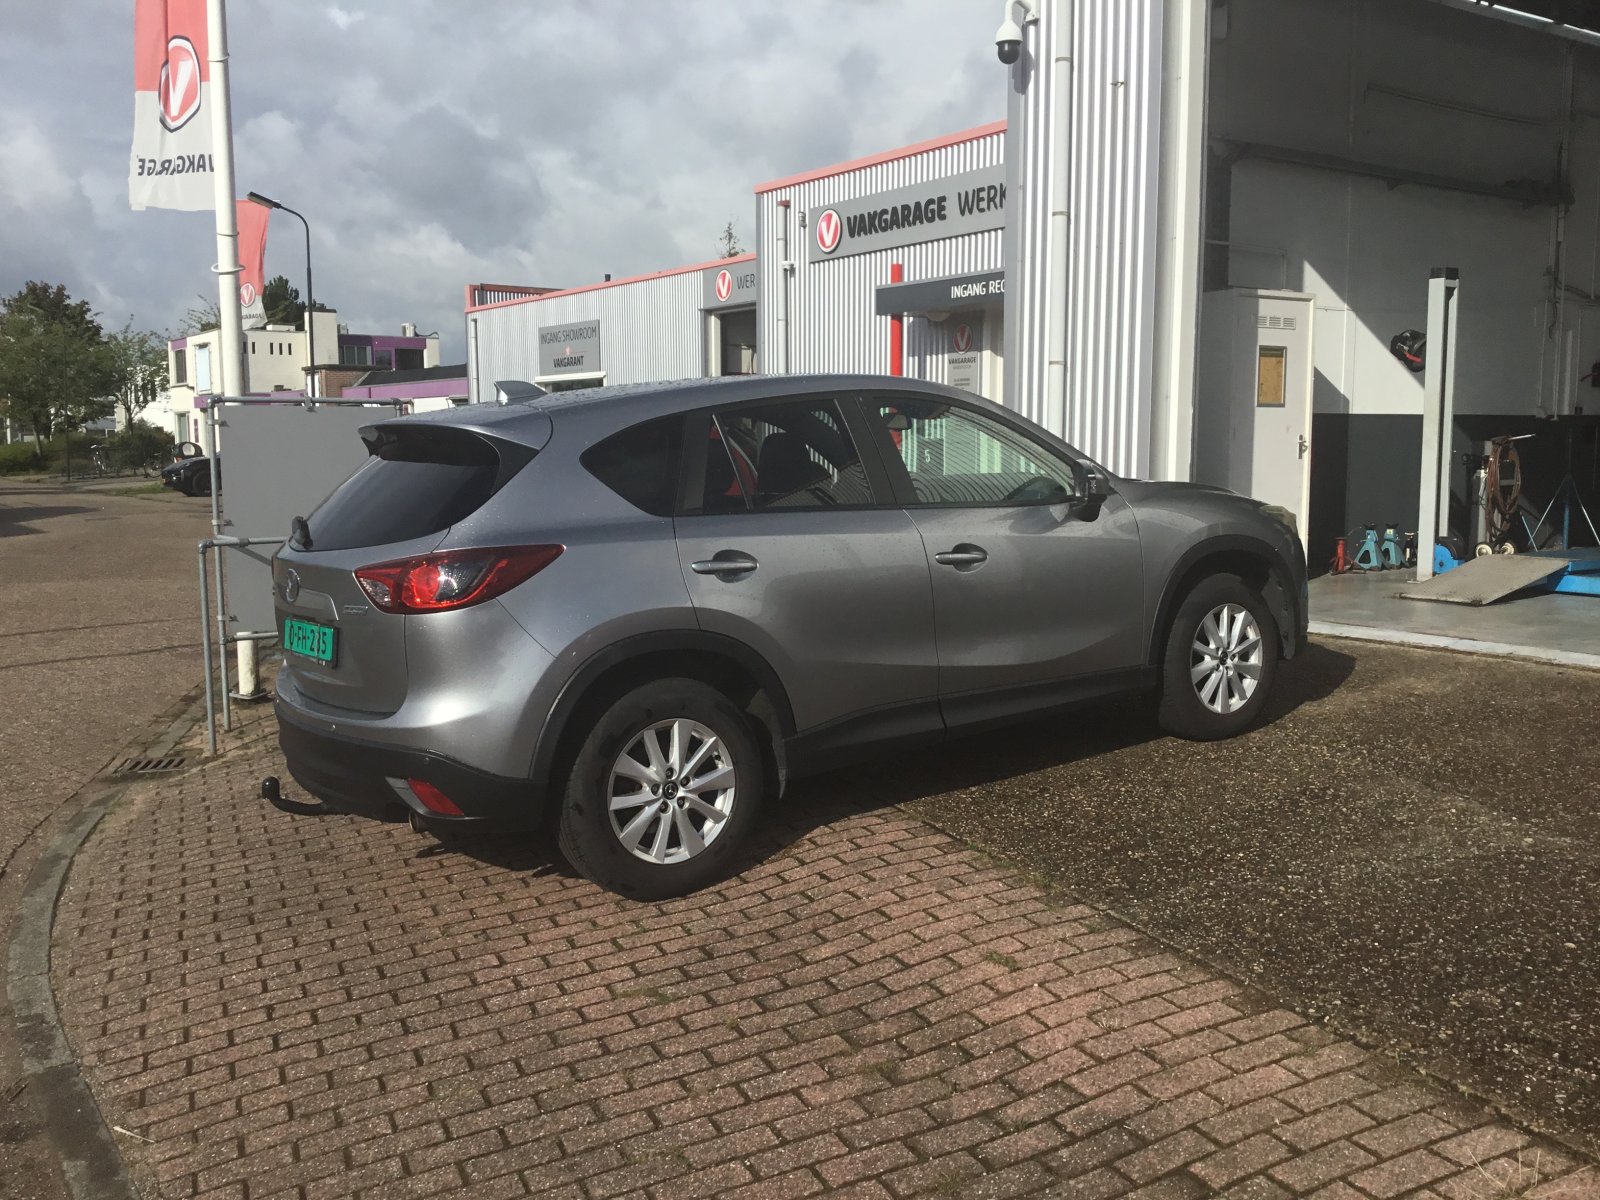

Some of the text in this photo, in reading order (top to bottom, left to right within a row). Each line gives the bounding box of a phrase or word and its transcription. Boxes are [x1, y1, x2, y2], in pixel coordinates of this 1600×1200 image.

[847, 195, 947, 239] VAKGARAGE
[736, 274, 756, 290] WER
[951, 282, 986, 299] INGANG
[541, 326, 597, 344] INGANG SHOWROOM
[553, 355, 584, 368] VAKGARANT
